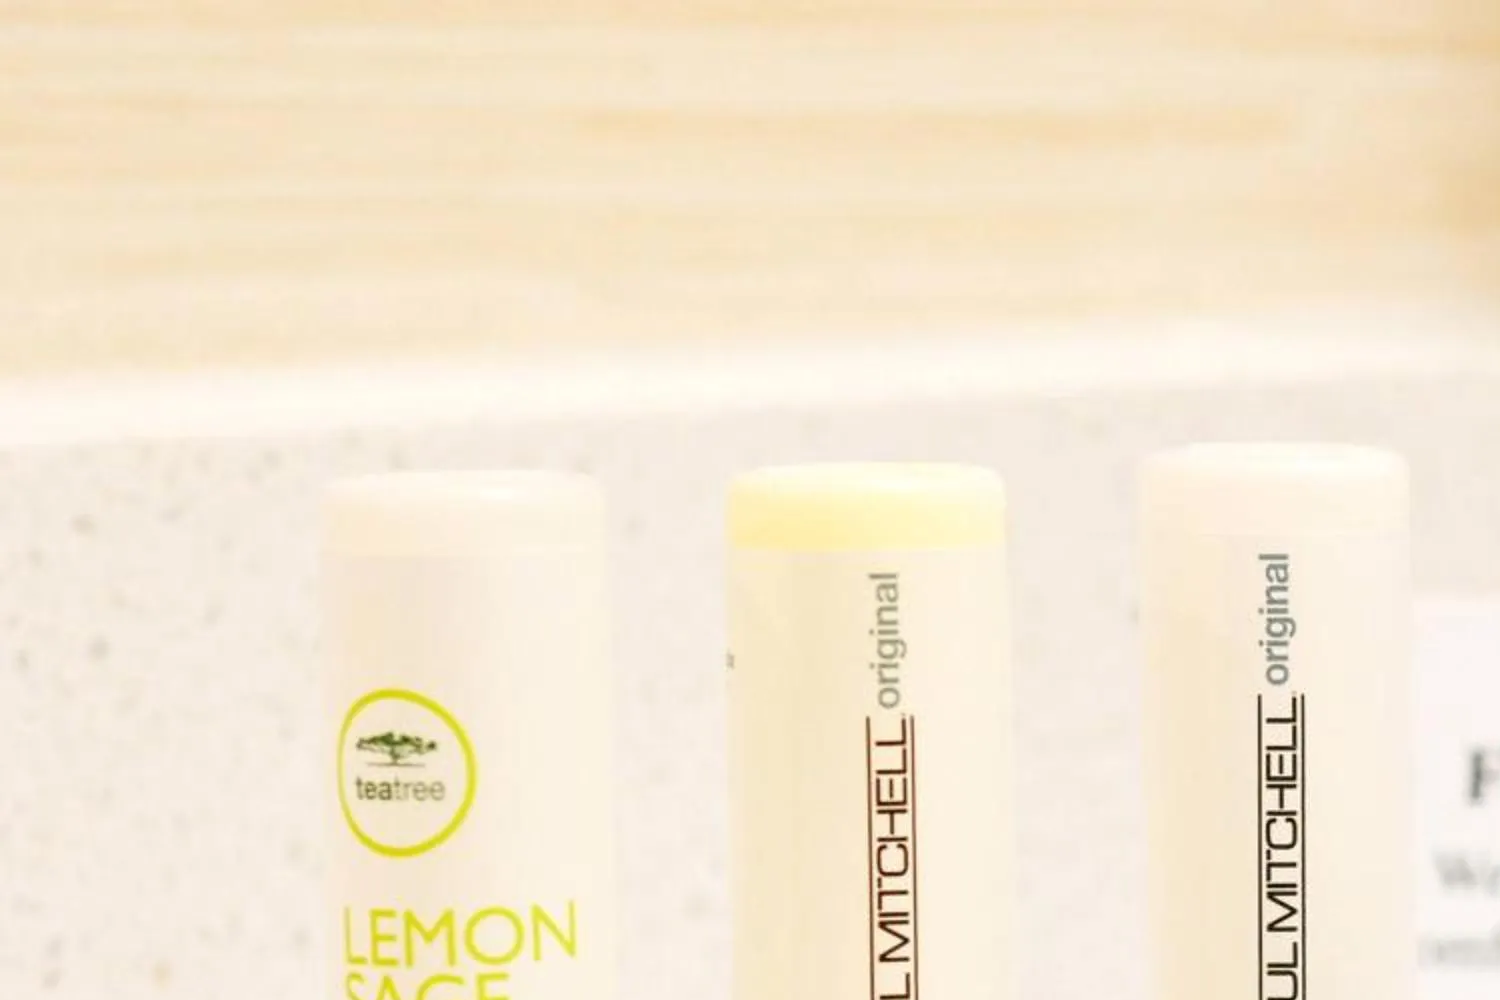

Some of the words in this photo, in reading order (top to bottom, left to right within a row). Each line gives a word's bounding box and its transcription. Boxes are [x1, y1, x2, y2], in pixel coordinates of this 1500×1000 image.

[868, 572, 907, 709] original
[1258, 553, 1297, 686] original
[874, 717, 910, 963] MITCHELL
[1265, 696, 1299, 932] MITCHELL
[343, 899, 578, 968] LEMON
